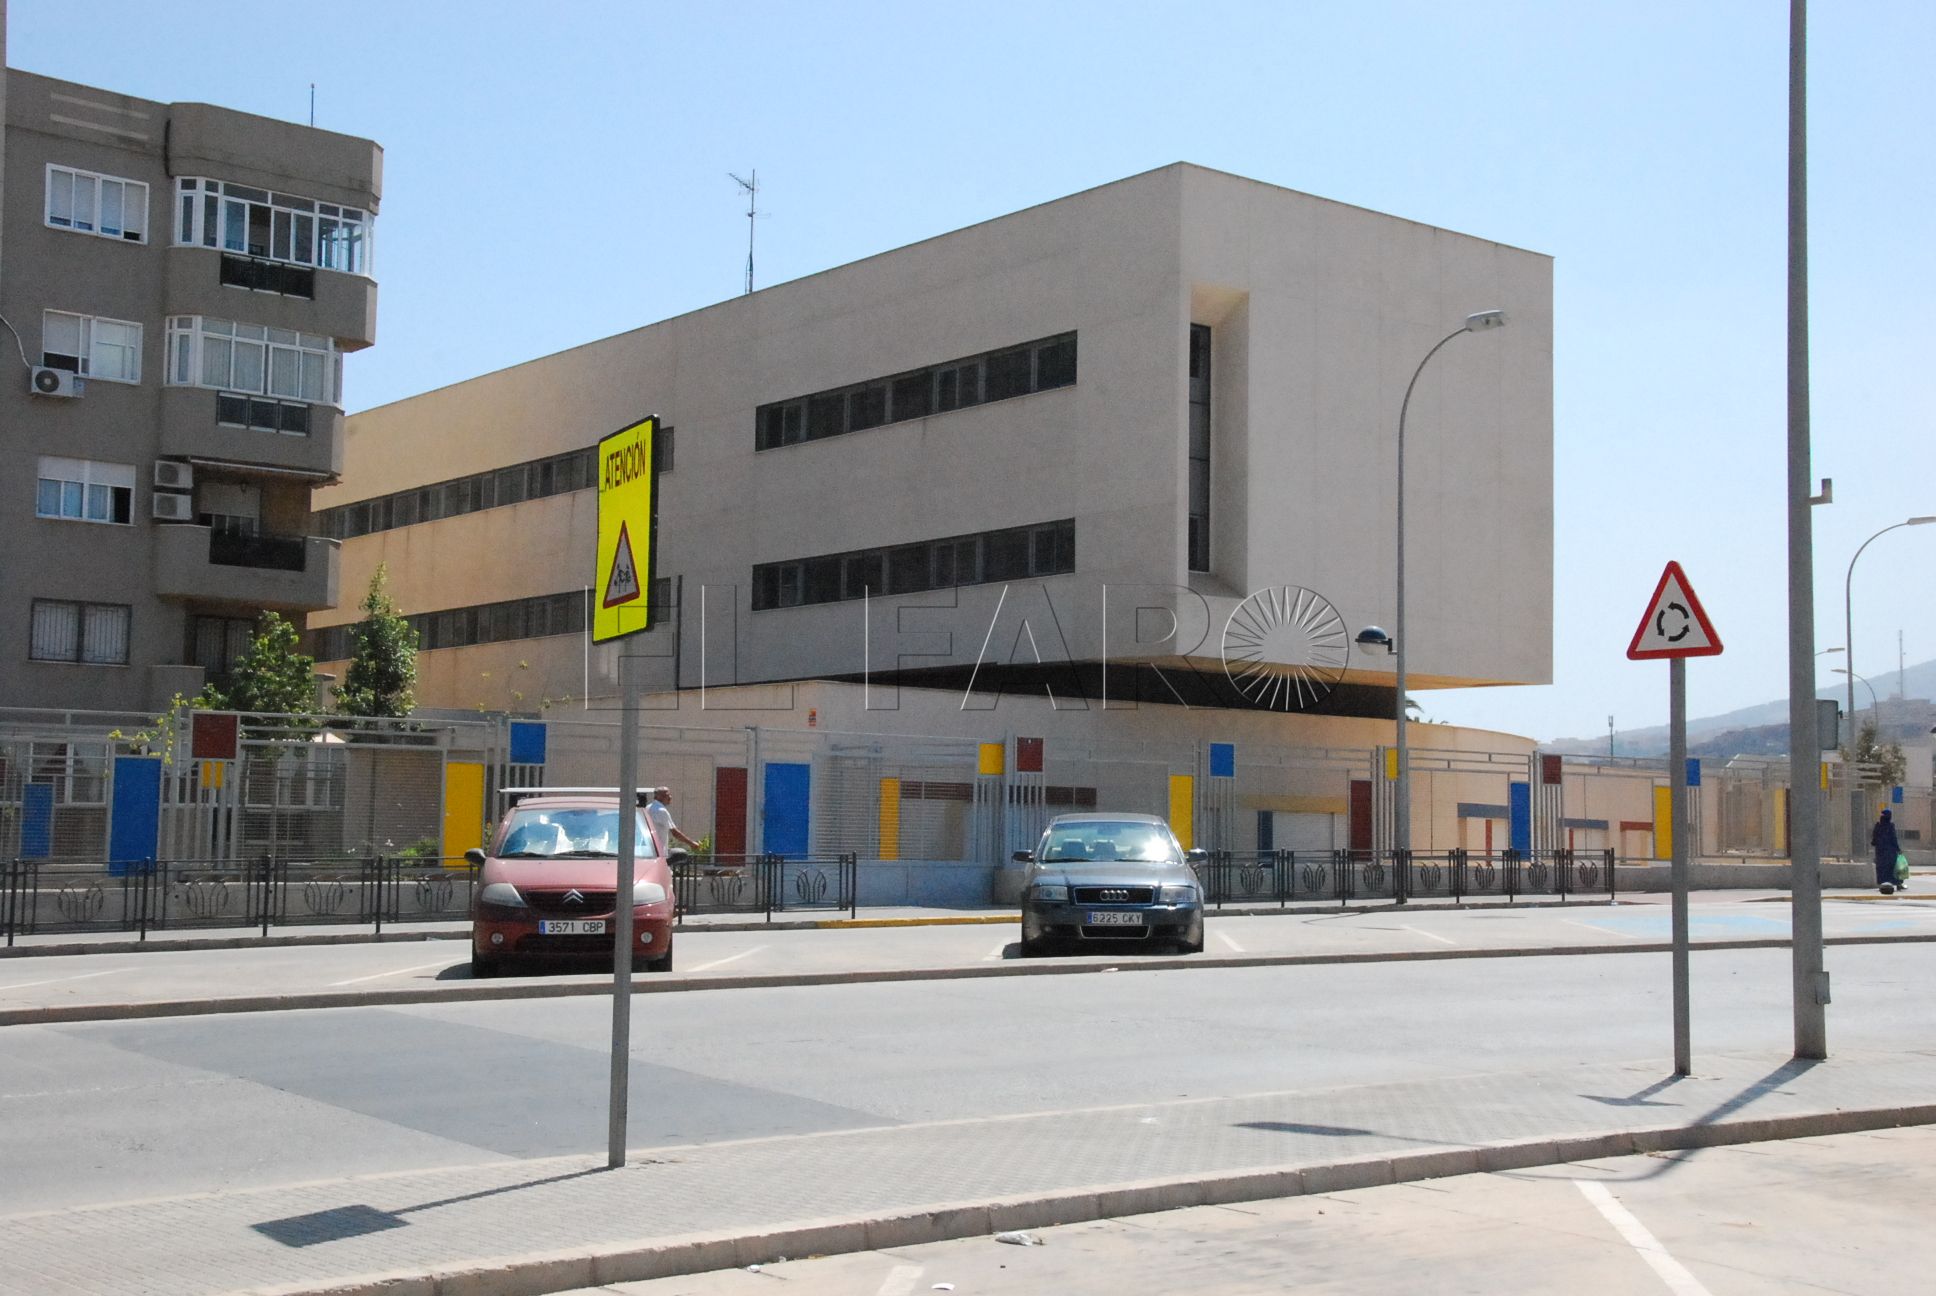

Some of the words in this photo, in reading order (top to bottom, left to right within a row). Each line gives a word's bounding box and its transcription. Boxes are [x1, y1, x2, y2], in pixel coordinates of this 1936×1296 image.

[1122, 913, 1142, 924] CKY
[548, 922, 575, 933] 3571
[582, 921, 604, 933] CBP
